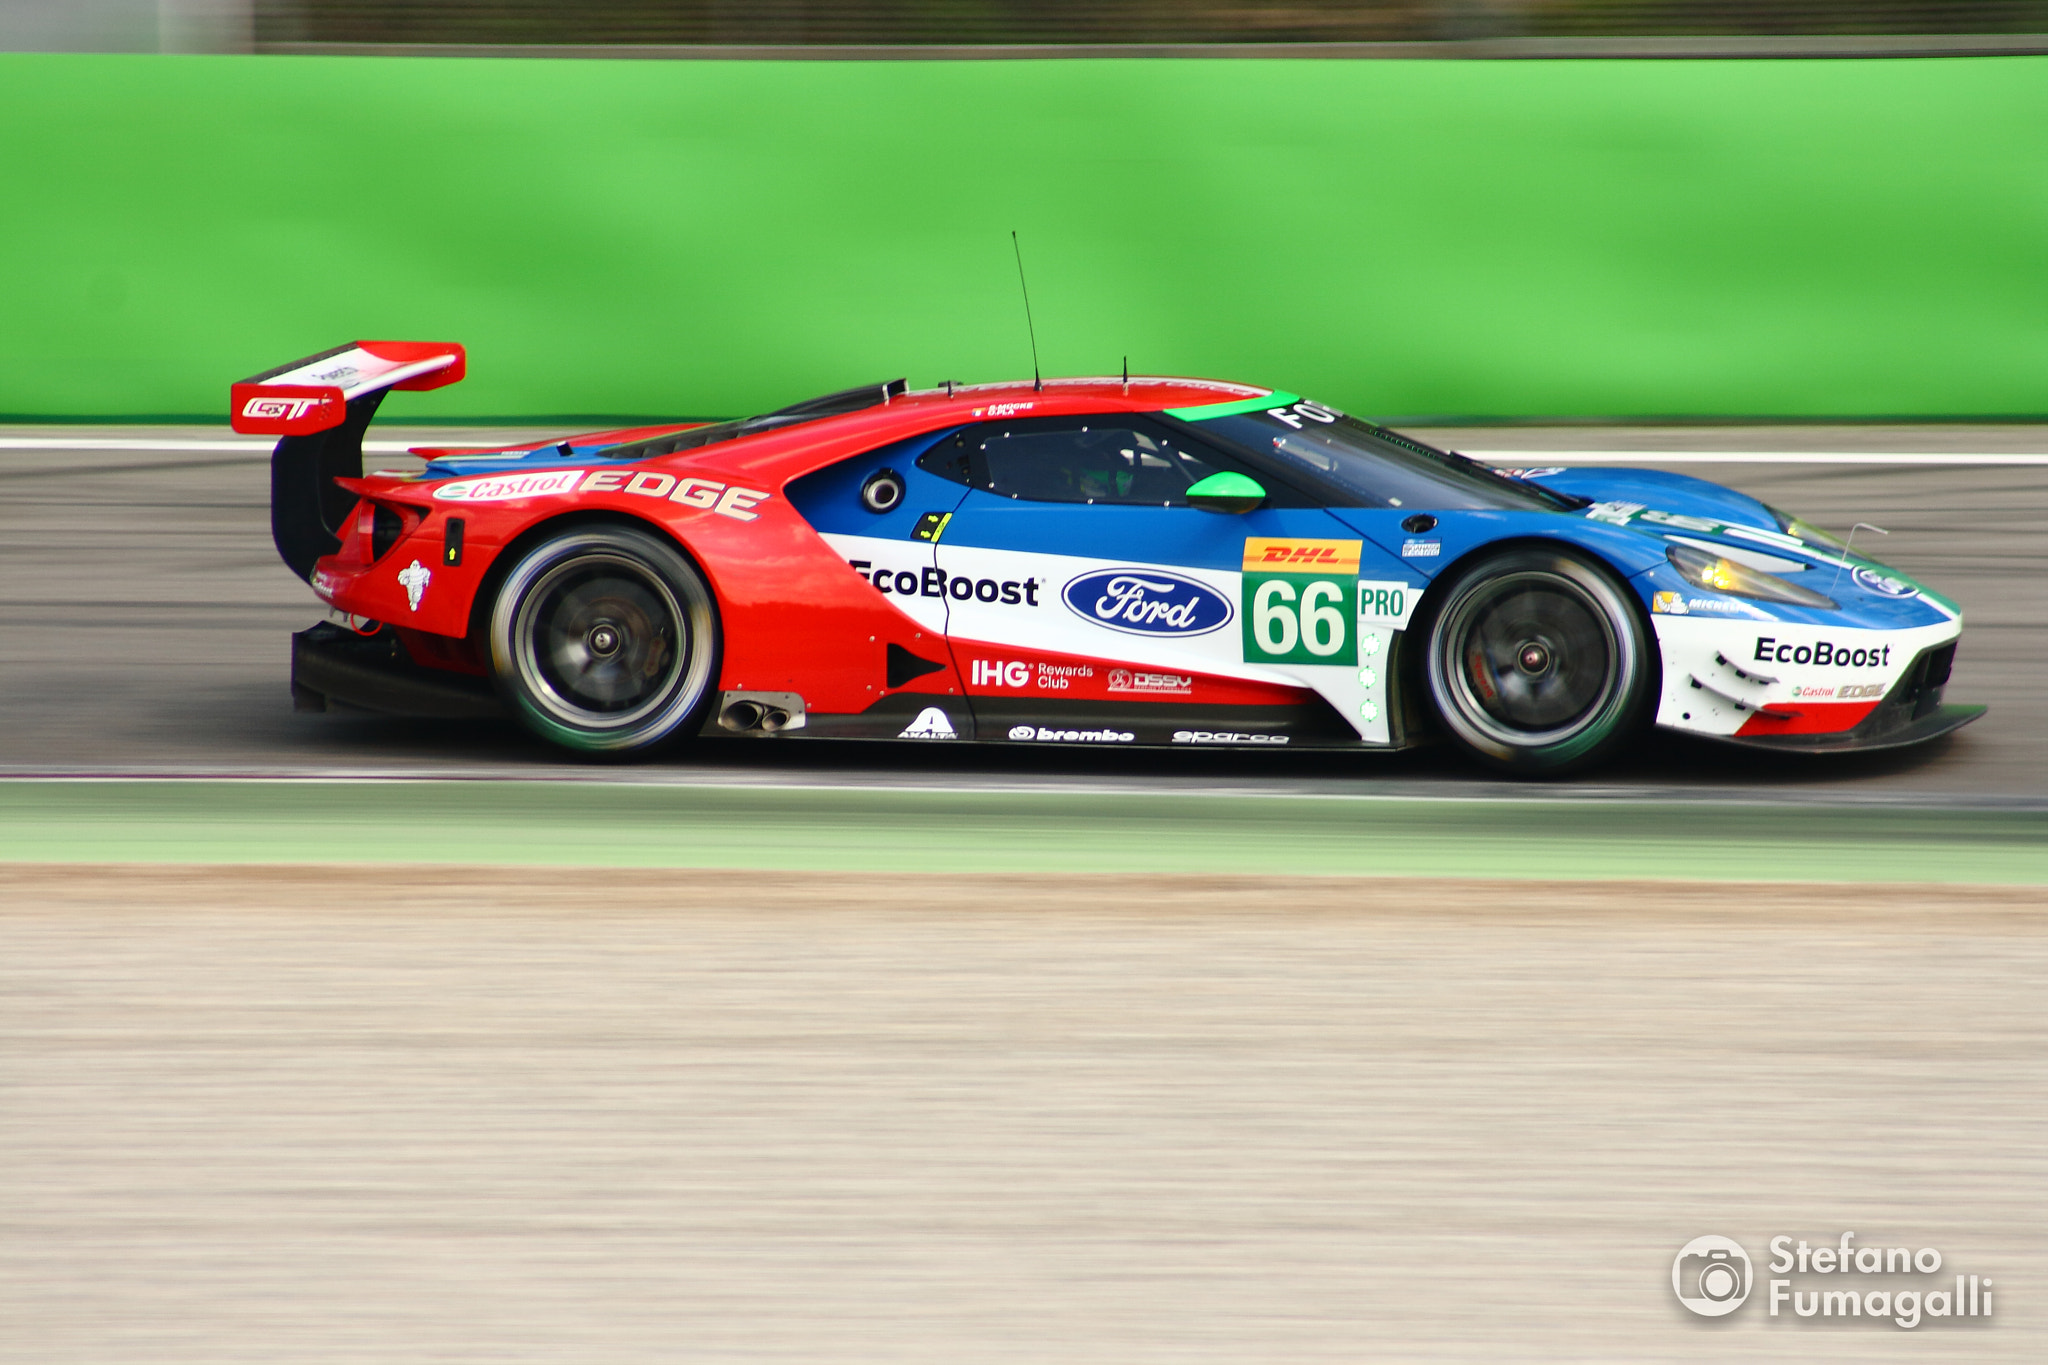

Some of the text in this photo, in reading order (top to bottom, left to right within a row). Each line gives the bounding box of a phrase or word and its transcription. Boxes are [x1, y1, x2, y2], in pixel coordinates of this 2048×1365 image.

[470, 470, 771, 522] Castrol EDGE
[1262, 546, 1340, 564] DHL
[1095, 576, 1200, 628] Ford
[1361, 588, 1404, 616] PRO
[1252, 579, 1346, 657] 66
[1753, 636, 1890, 667] EcoBoost
[971, 659, 1094, 688] IHG Rewards
[1037, 675, 1069, 690] Club
[1133, 672, 1192, 688] DSSV
[1801, 682, 1886, 699] Castrol EDGE
[1036, 727, 1135, 742] brembo
[1171, 730, 1290, 744] sparco
